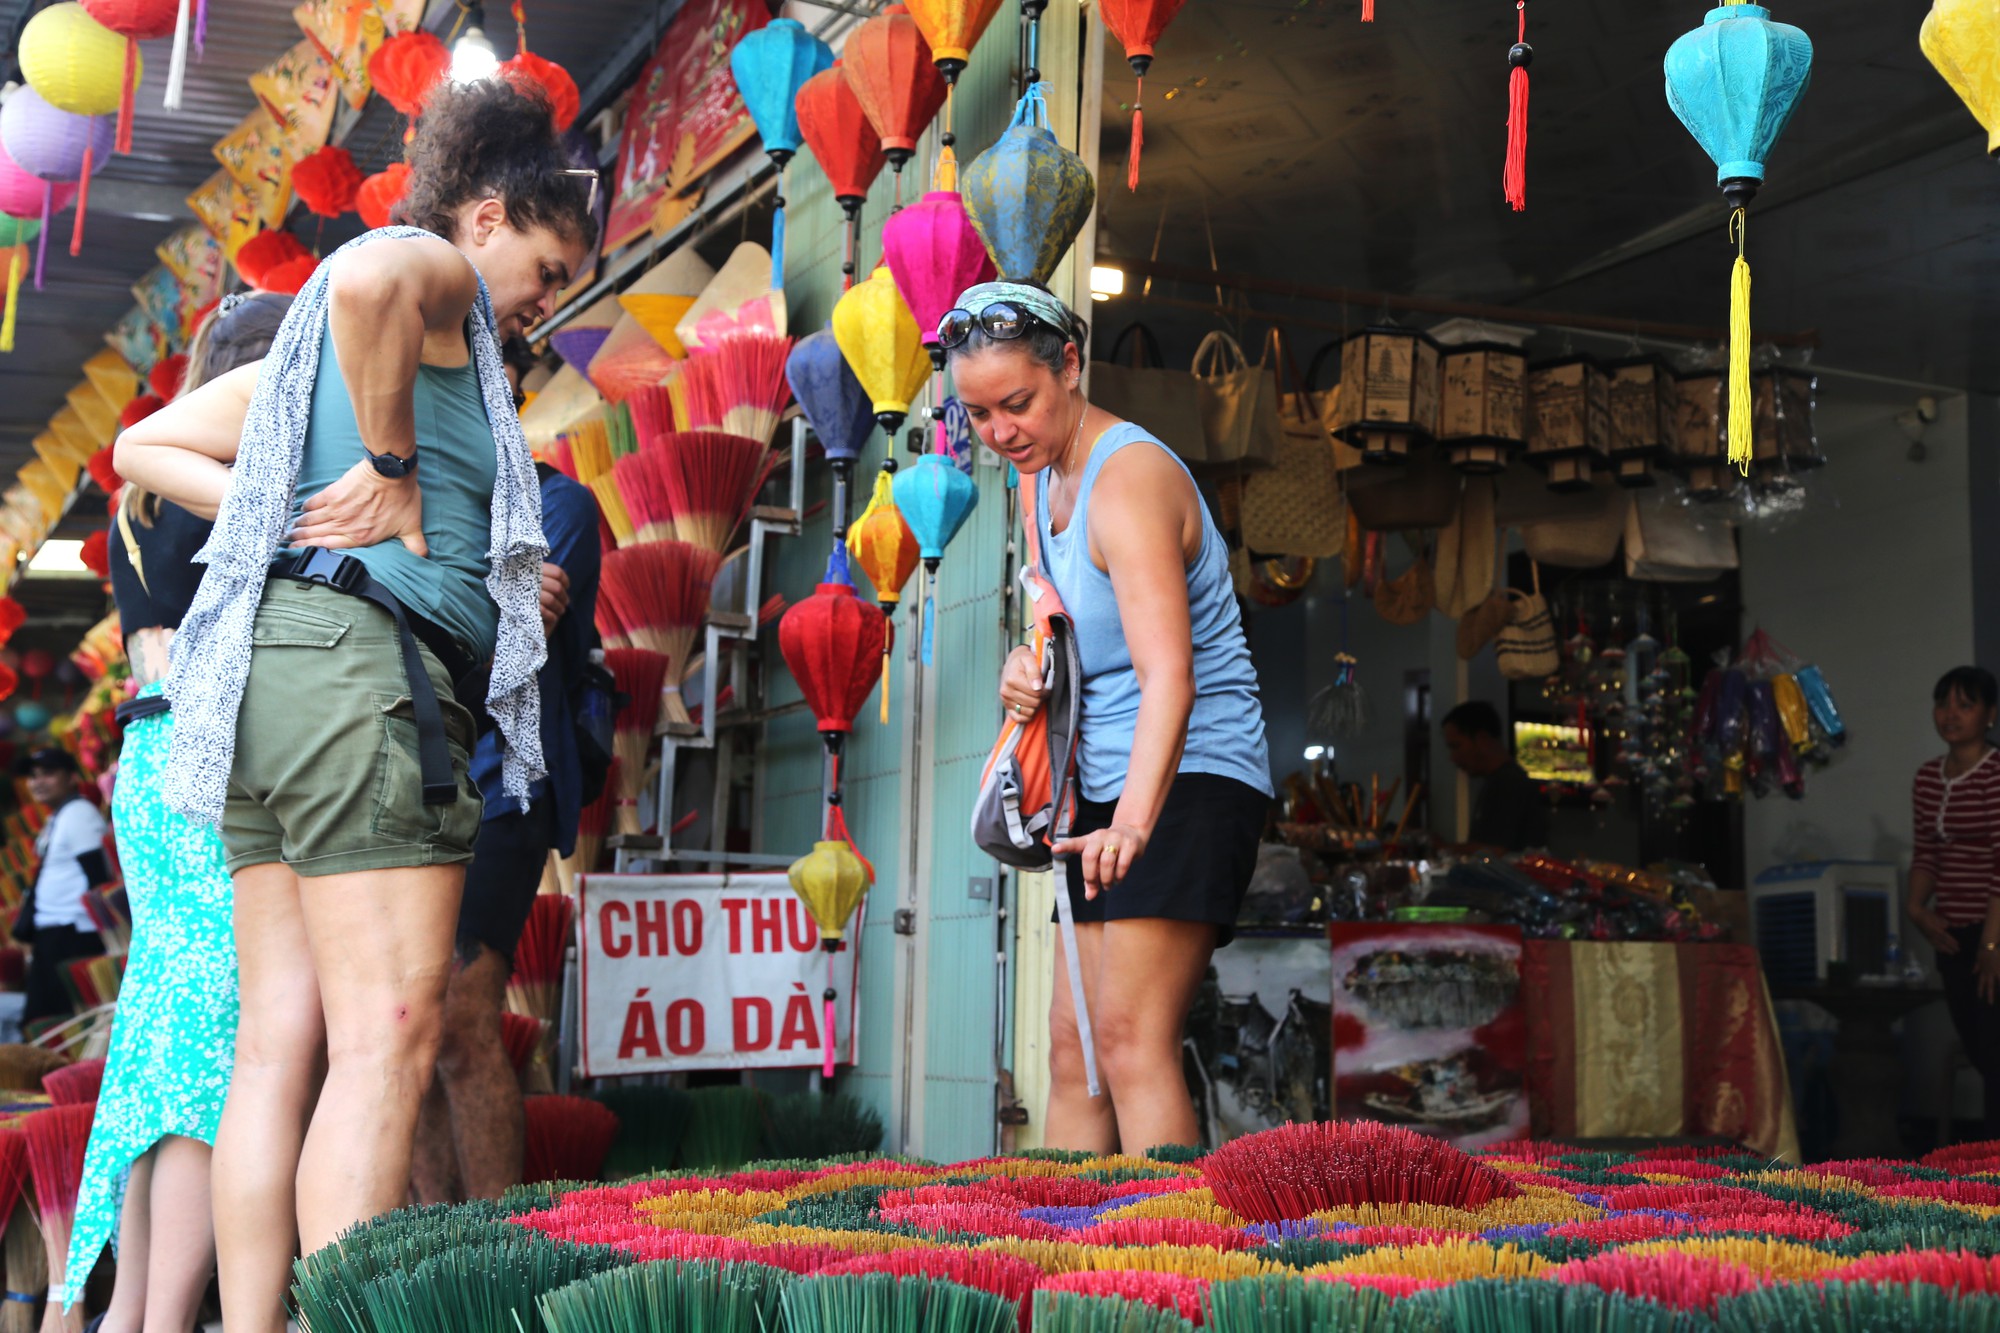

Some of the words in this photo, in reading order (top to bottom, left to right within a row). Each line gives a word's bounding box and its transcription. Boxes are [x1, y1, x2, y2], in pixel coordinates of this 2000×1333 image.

[600, 898, 704, 958] CHO
[721, 898, 847, 953] THU
[617, 987, 705, 1059] ÁO
[732, 982, 836, 1051] DÀ
